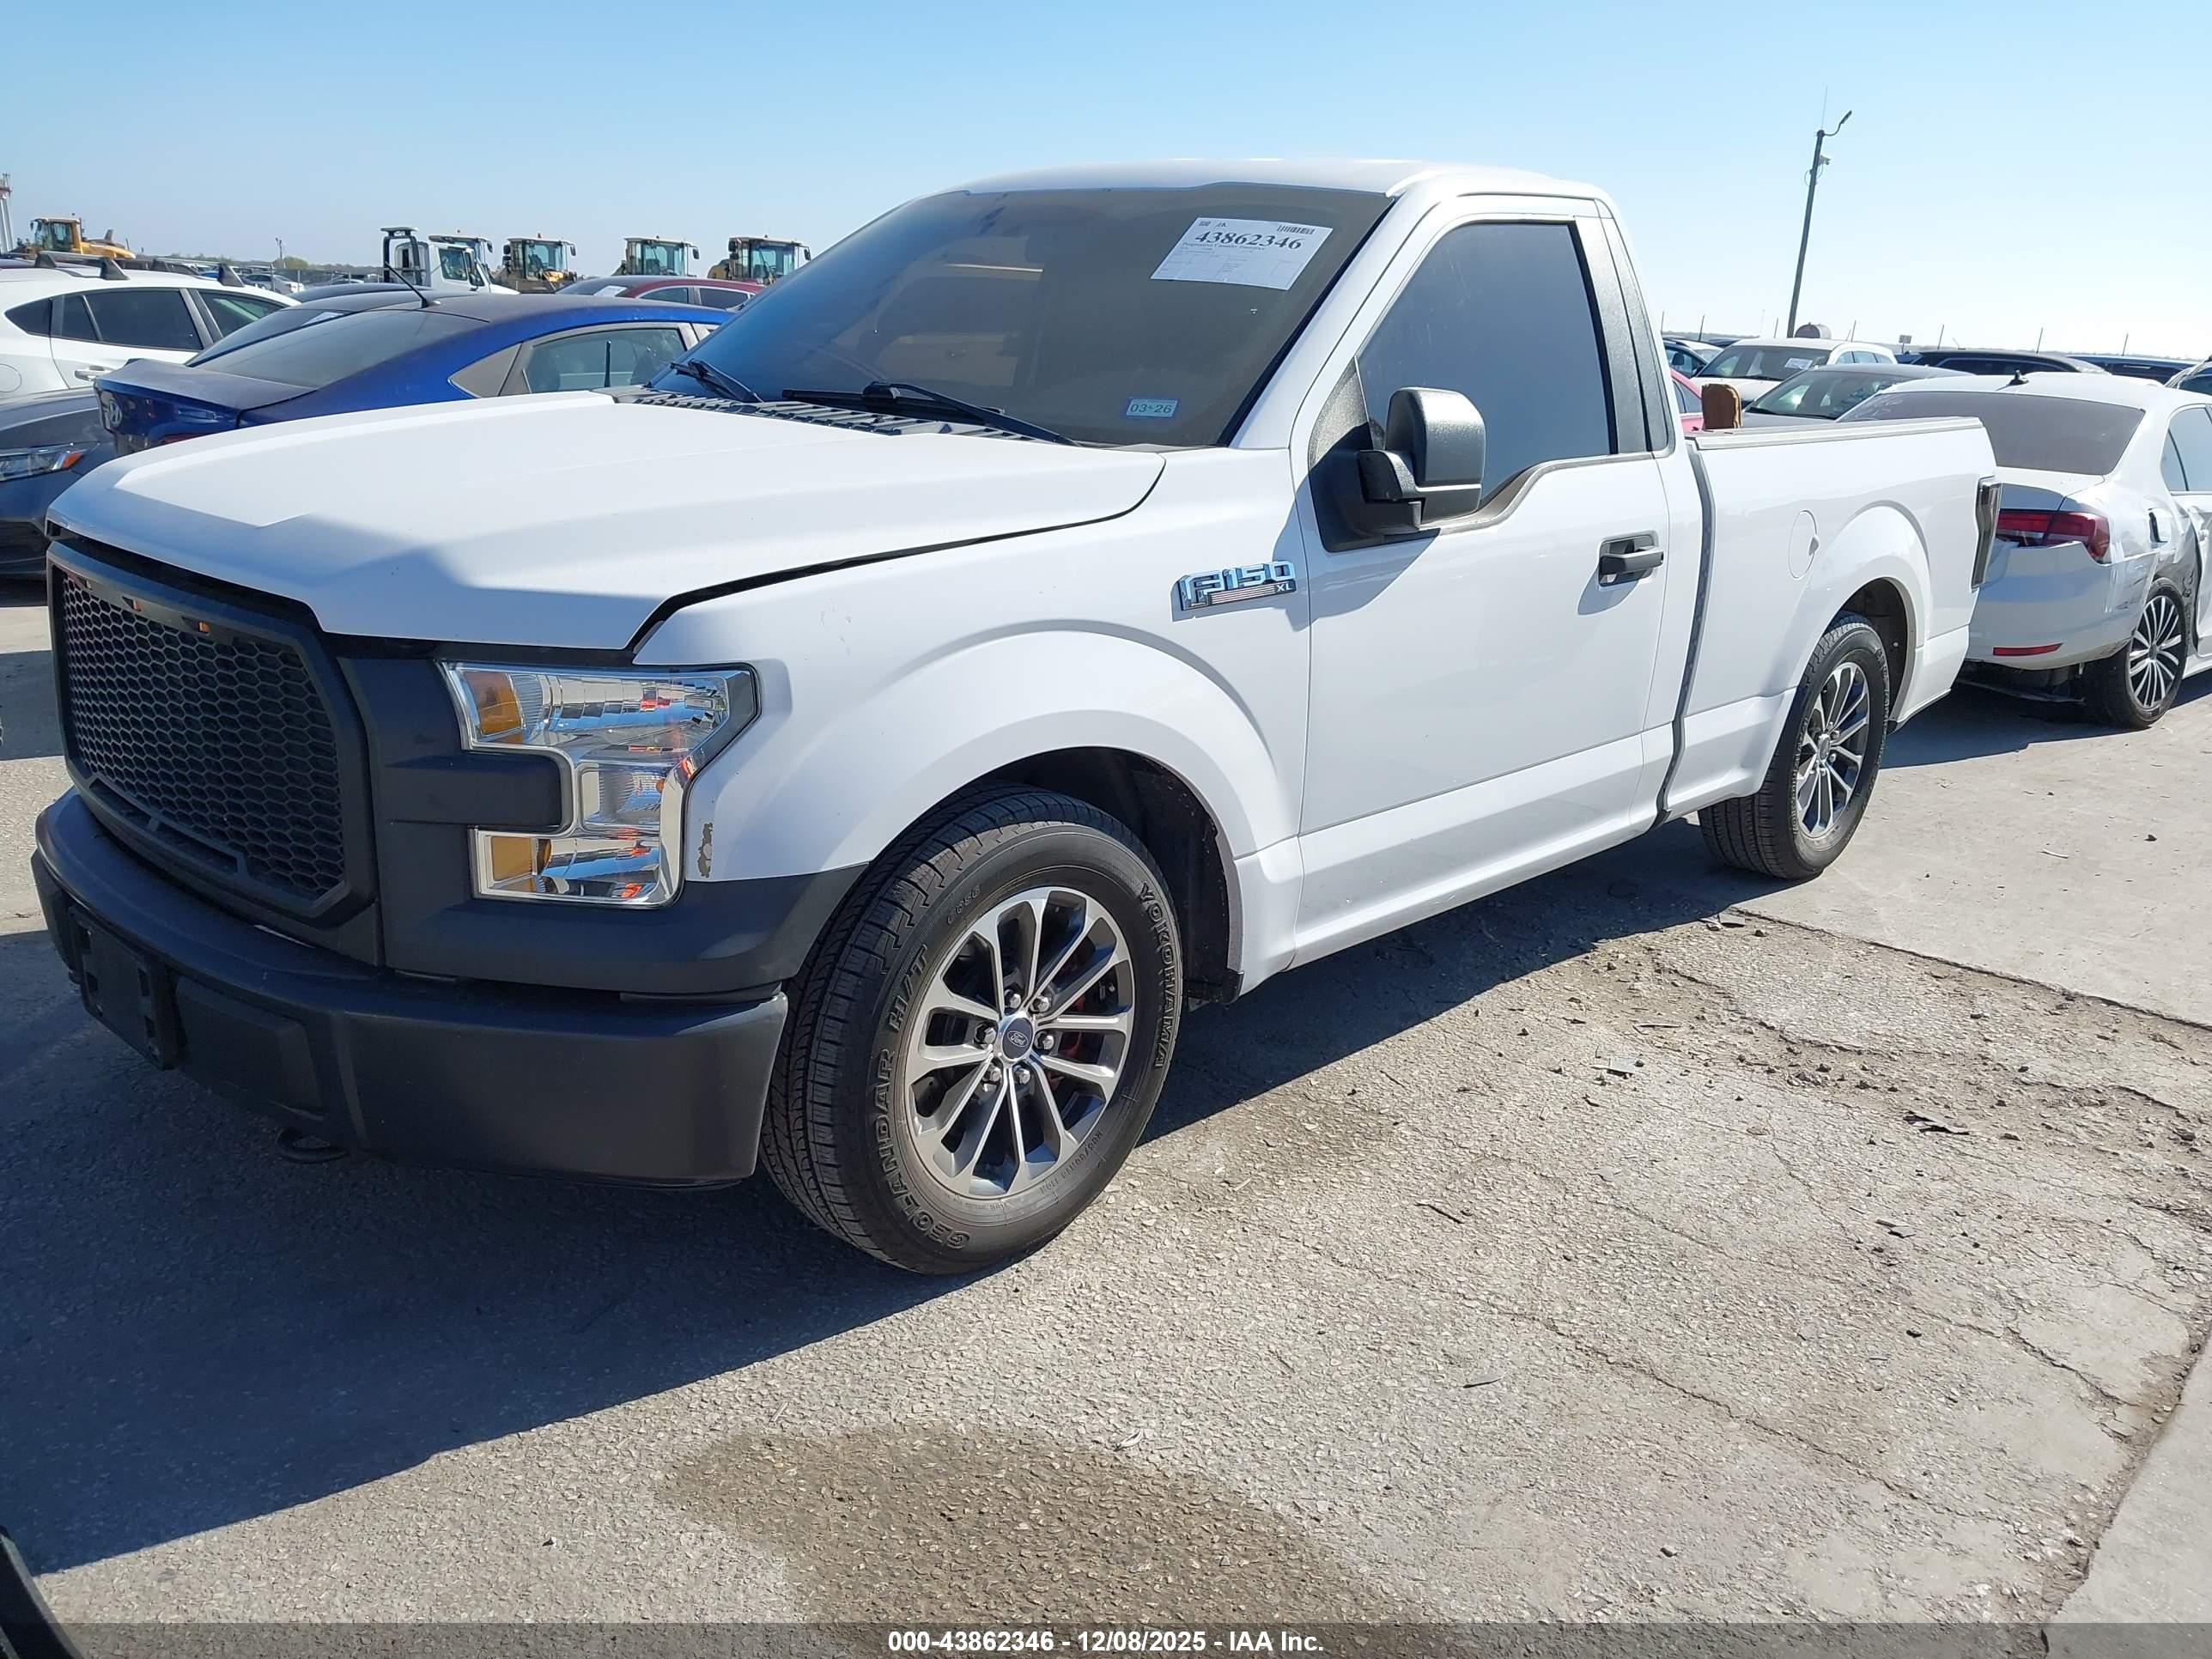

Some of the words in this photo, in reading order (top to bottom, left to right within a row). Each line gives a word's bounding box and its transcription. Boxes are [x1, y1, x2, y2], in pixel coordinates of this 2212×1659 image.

[1195, 230, 1305, 250] 43862346
[1276, 582, 1293, 592] XL
[889, 944, 929, 1032] H/T
[1138, 881, 1177, 1068] YOKOHAMA
[874, 1048, 971, 1249] GEOLANDAR
